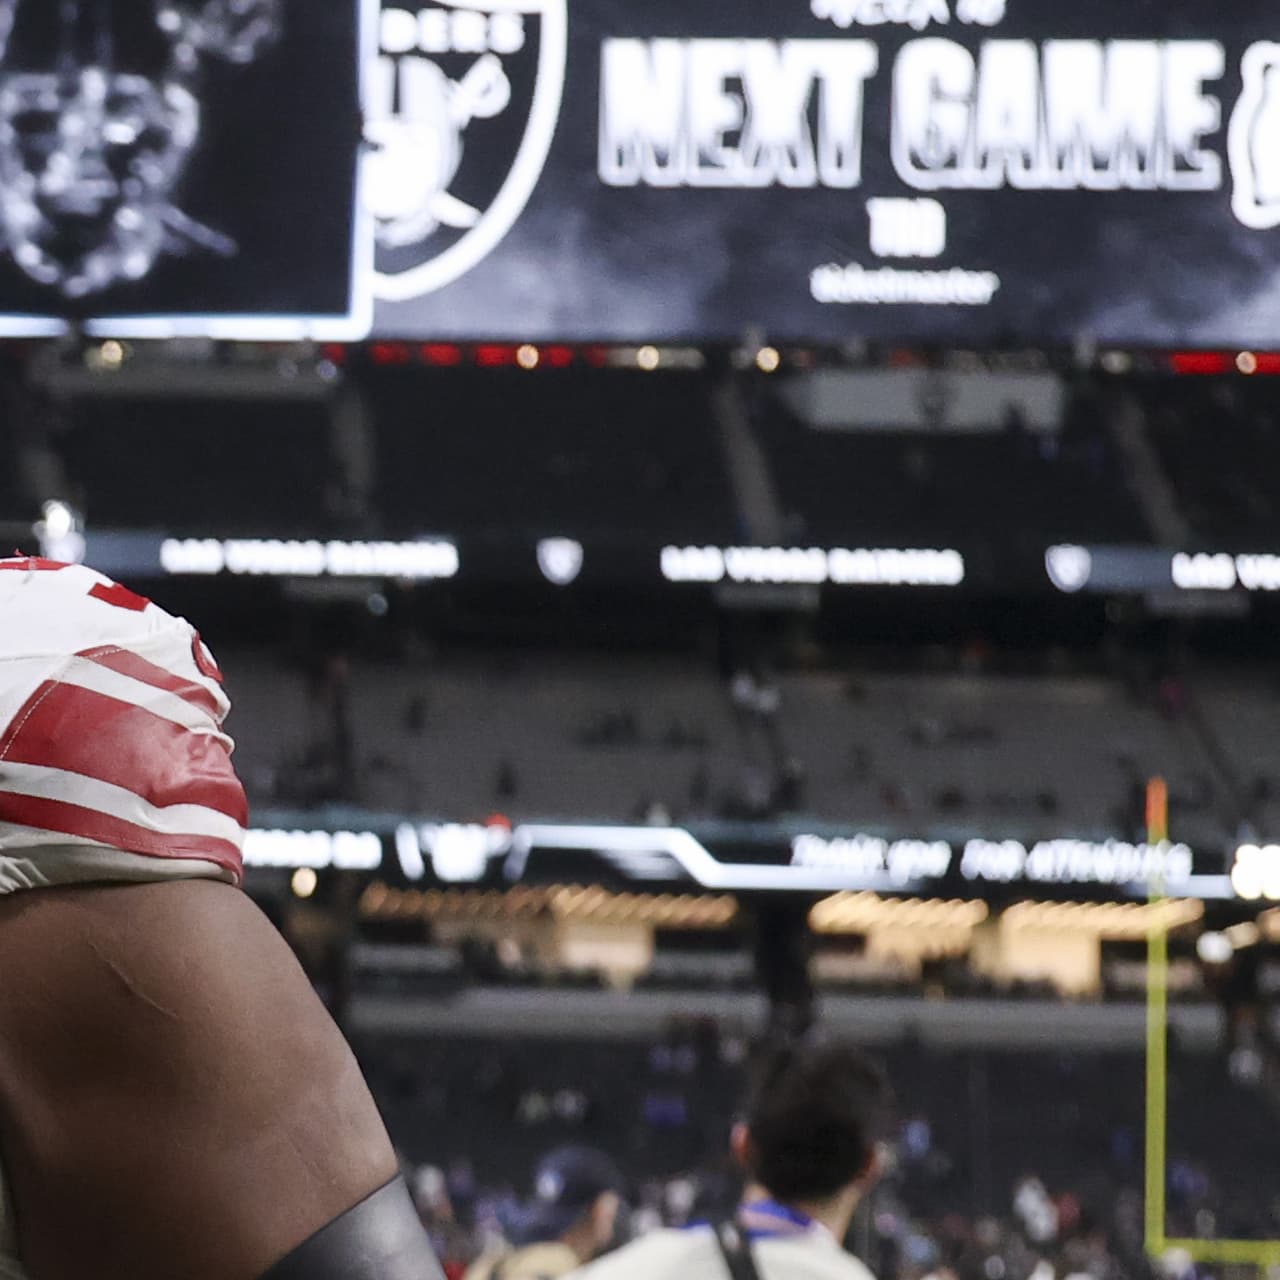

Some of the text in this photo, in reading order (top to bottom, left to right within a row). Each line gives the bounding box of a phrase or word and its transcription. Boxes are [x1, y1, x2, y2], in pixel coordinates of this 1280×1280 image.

[381, 8, 525, 53] DERS
[598, 38, 1225, 190] NEXT GAME
